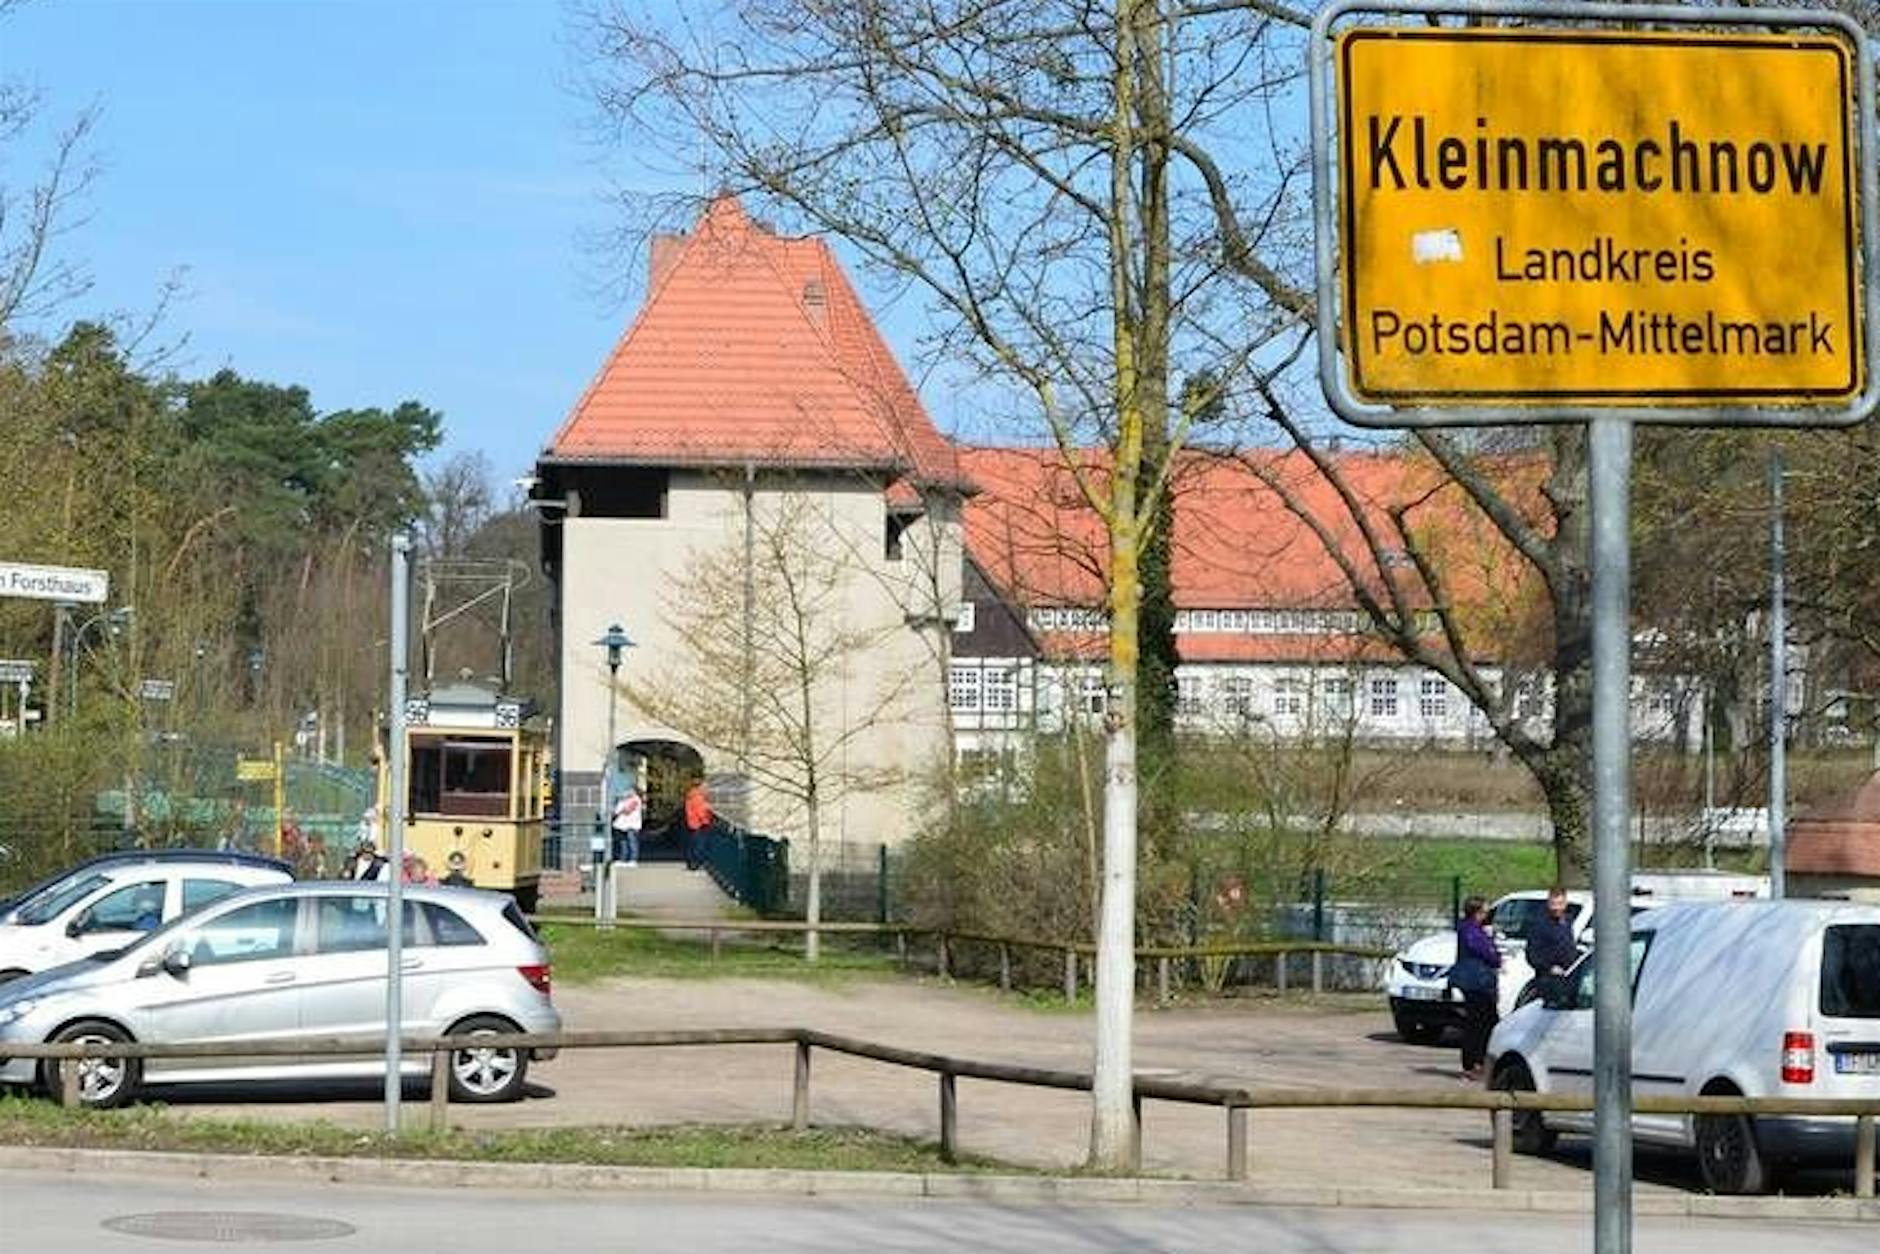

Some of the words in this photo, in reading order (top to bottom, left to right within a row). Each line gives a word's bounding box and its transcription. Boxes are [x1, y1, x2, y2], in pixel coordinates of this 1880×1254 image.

[1367, 116, 1828, 194] Kleinmachnow
[1495, 236, 1715, 282] Landkreis
[1371, 310, 1834, 357] Potsdam-Mittelmark
[10, 572, 92, 595] Forsthaus
